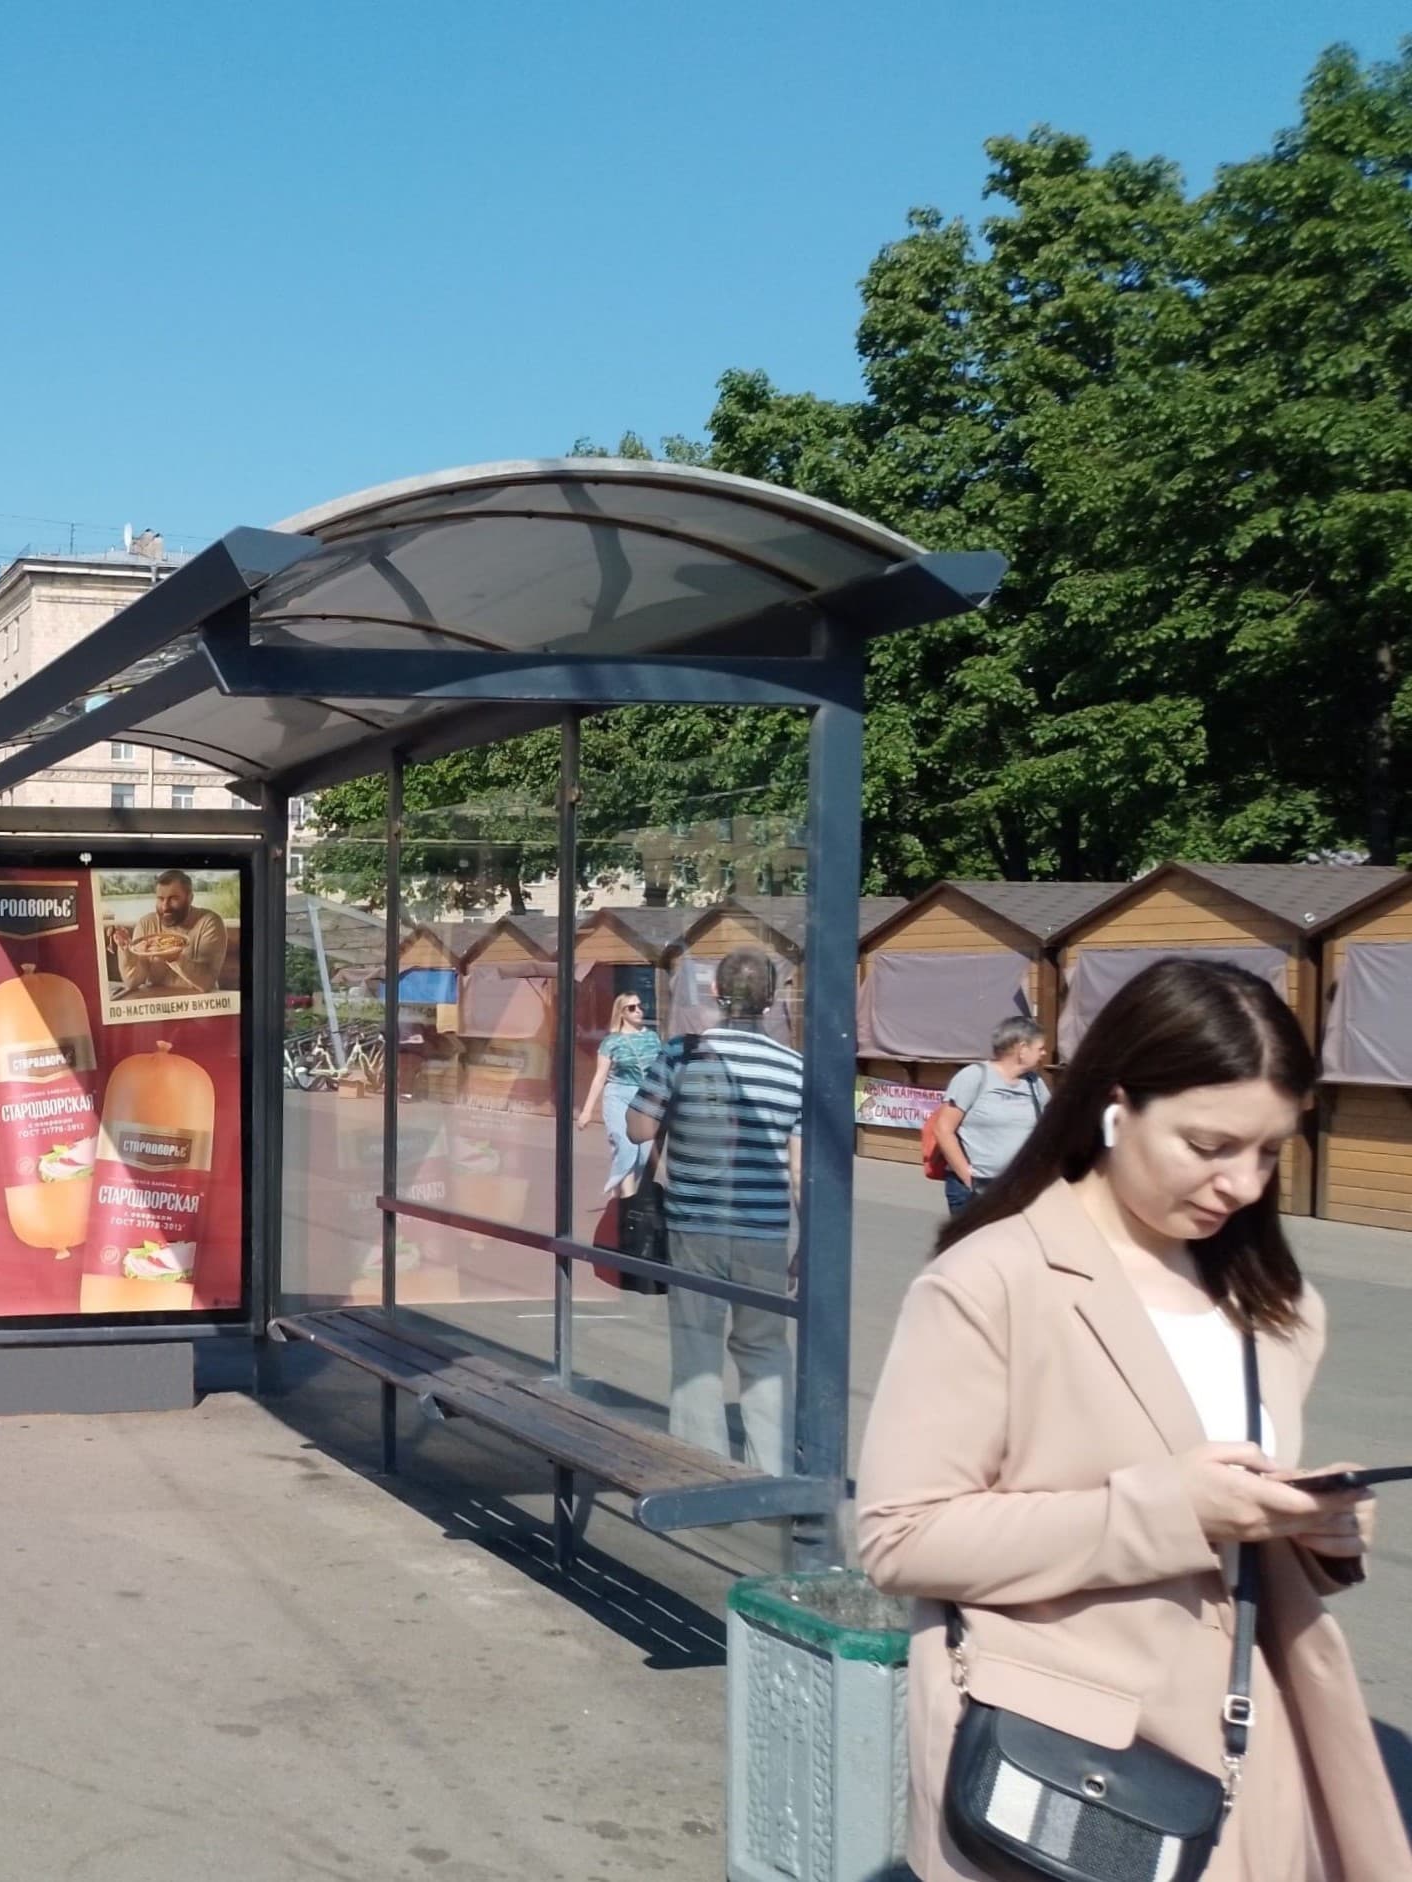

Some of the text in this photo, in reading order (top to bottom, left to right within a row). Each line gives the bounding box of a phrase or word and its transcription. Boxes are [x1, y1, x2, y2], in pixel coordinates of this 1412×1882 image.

[109, 997, 231, 1018] ПО-НАСТОЯЩЕМУ ВКУСНО!
[1, 1094, 94, 1122] СТАРОДВОРСКАЯ
[874, 1104, 920, 1121] СЛАДОСТИ
[99, 1185, 199, 1213] СТАРОДВОРСКАЯ
